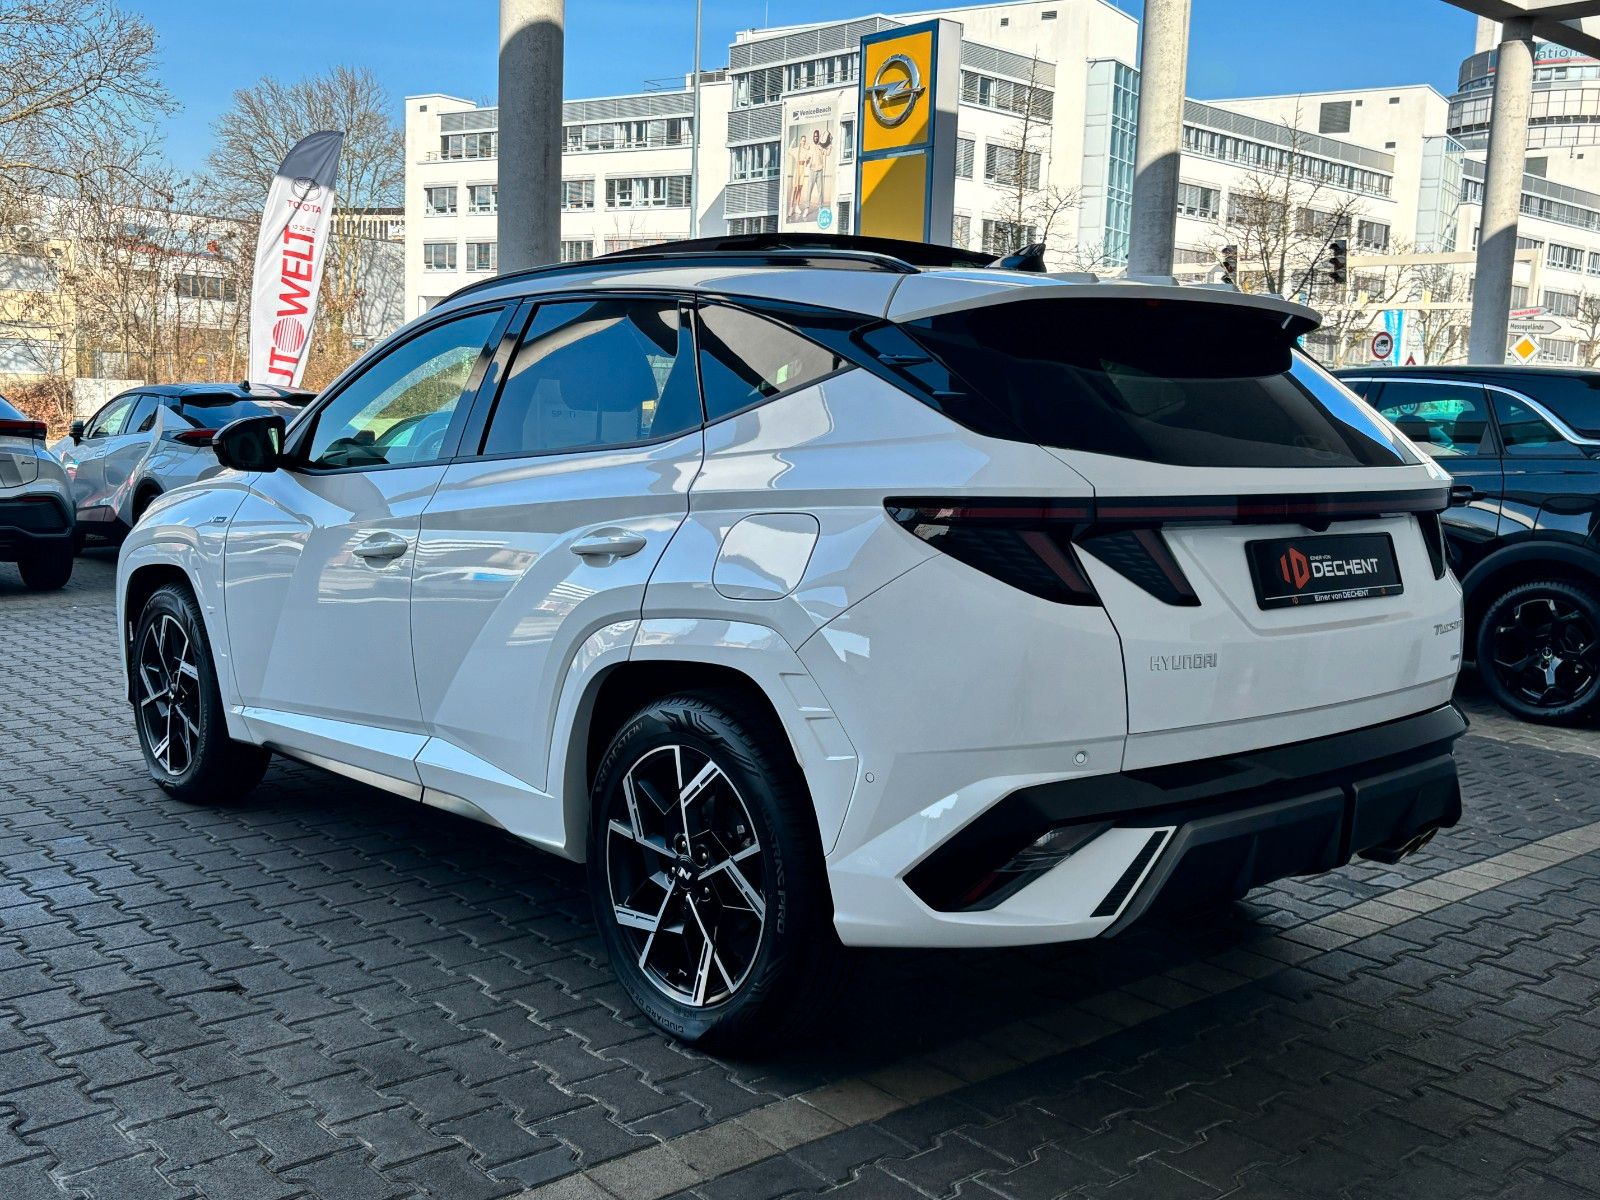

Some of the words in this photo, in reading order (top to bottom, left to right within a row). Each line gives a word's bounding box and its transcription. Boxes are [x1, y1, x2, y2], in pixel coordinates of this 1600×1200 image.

[1311, 558, 1378, 578] DECHENT
[1314, 593, 1331, 602] Einer
[1331, 593, 1343, 601] von
[1342, 589, 1369, 599] DECHENT
[1150, 652, 1217, 671] HYUNDAI
